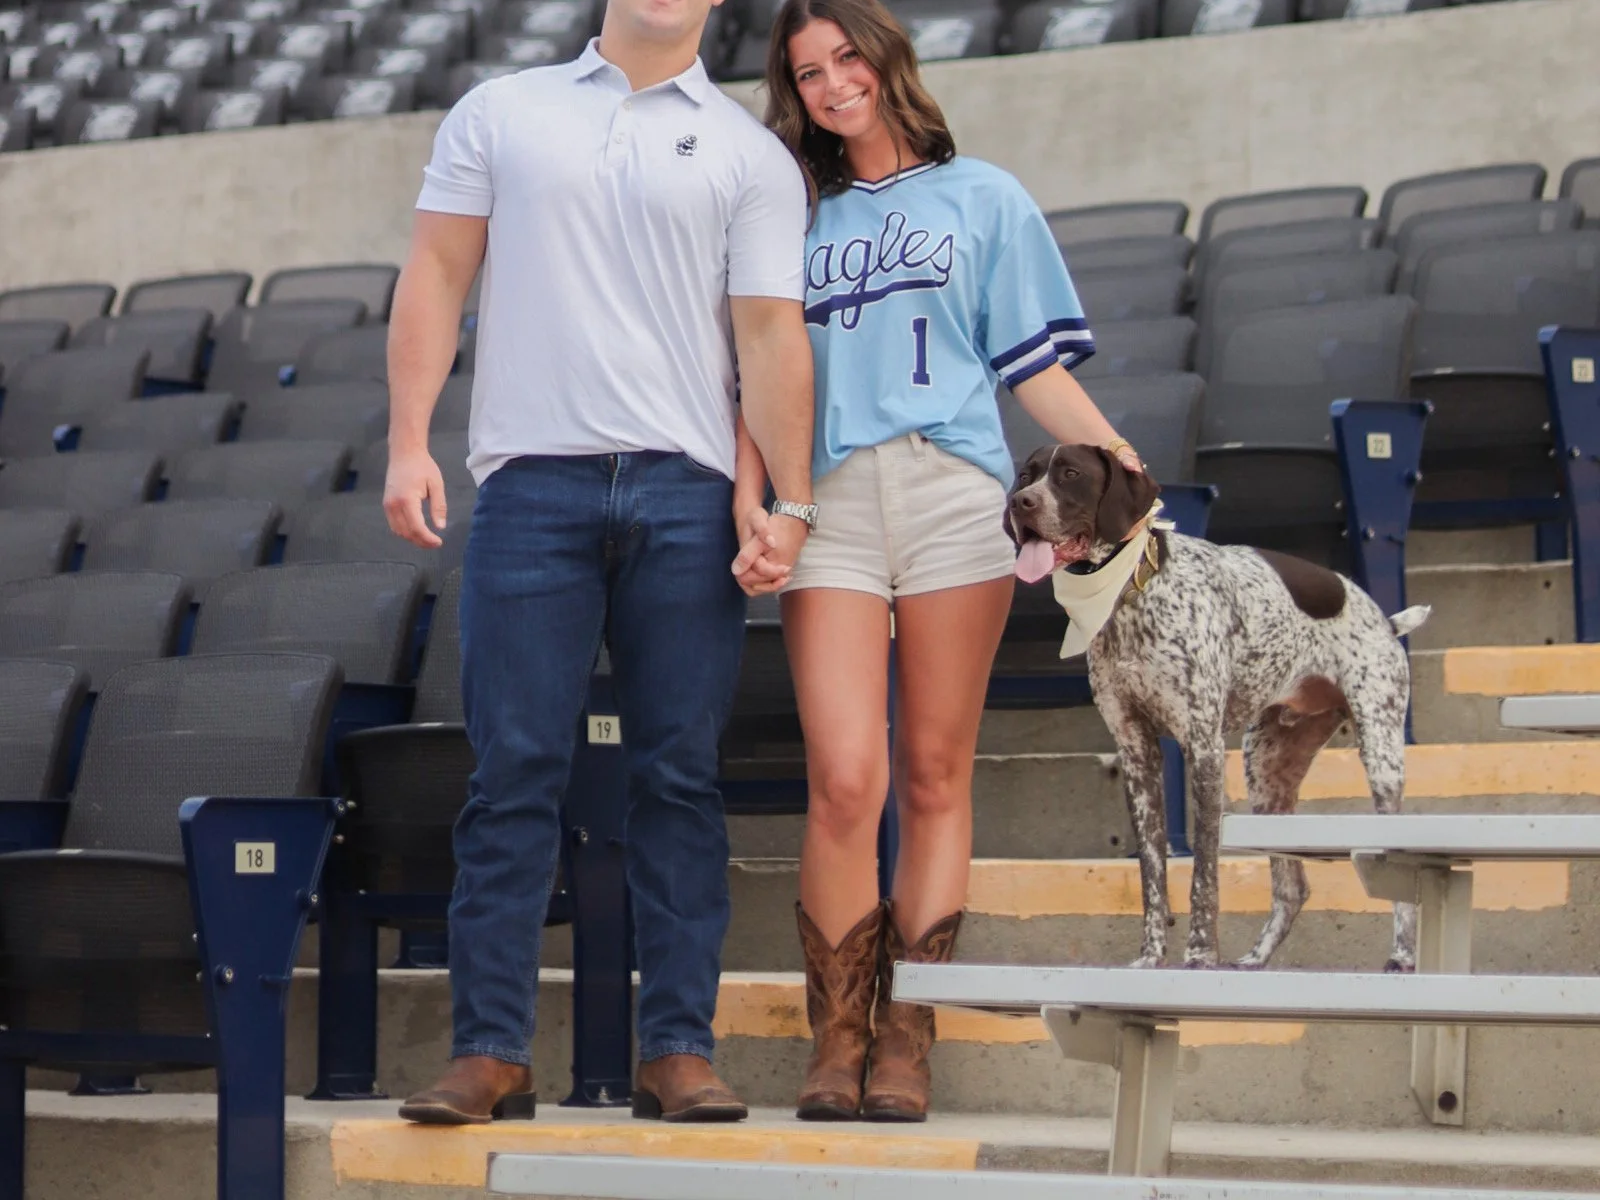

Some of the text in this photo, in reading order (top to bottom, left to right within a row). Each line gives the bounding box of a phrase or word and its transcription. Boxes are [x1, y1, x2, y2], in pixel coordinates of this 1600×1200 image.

[803, 211, 953, 331] agles
[911, 316, 931, 386] 1
[596, 721, 612, 739] 19
[246, 848, 264, 869] 18
